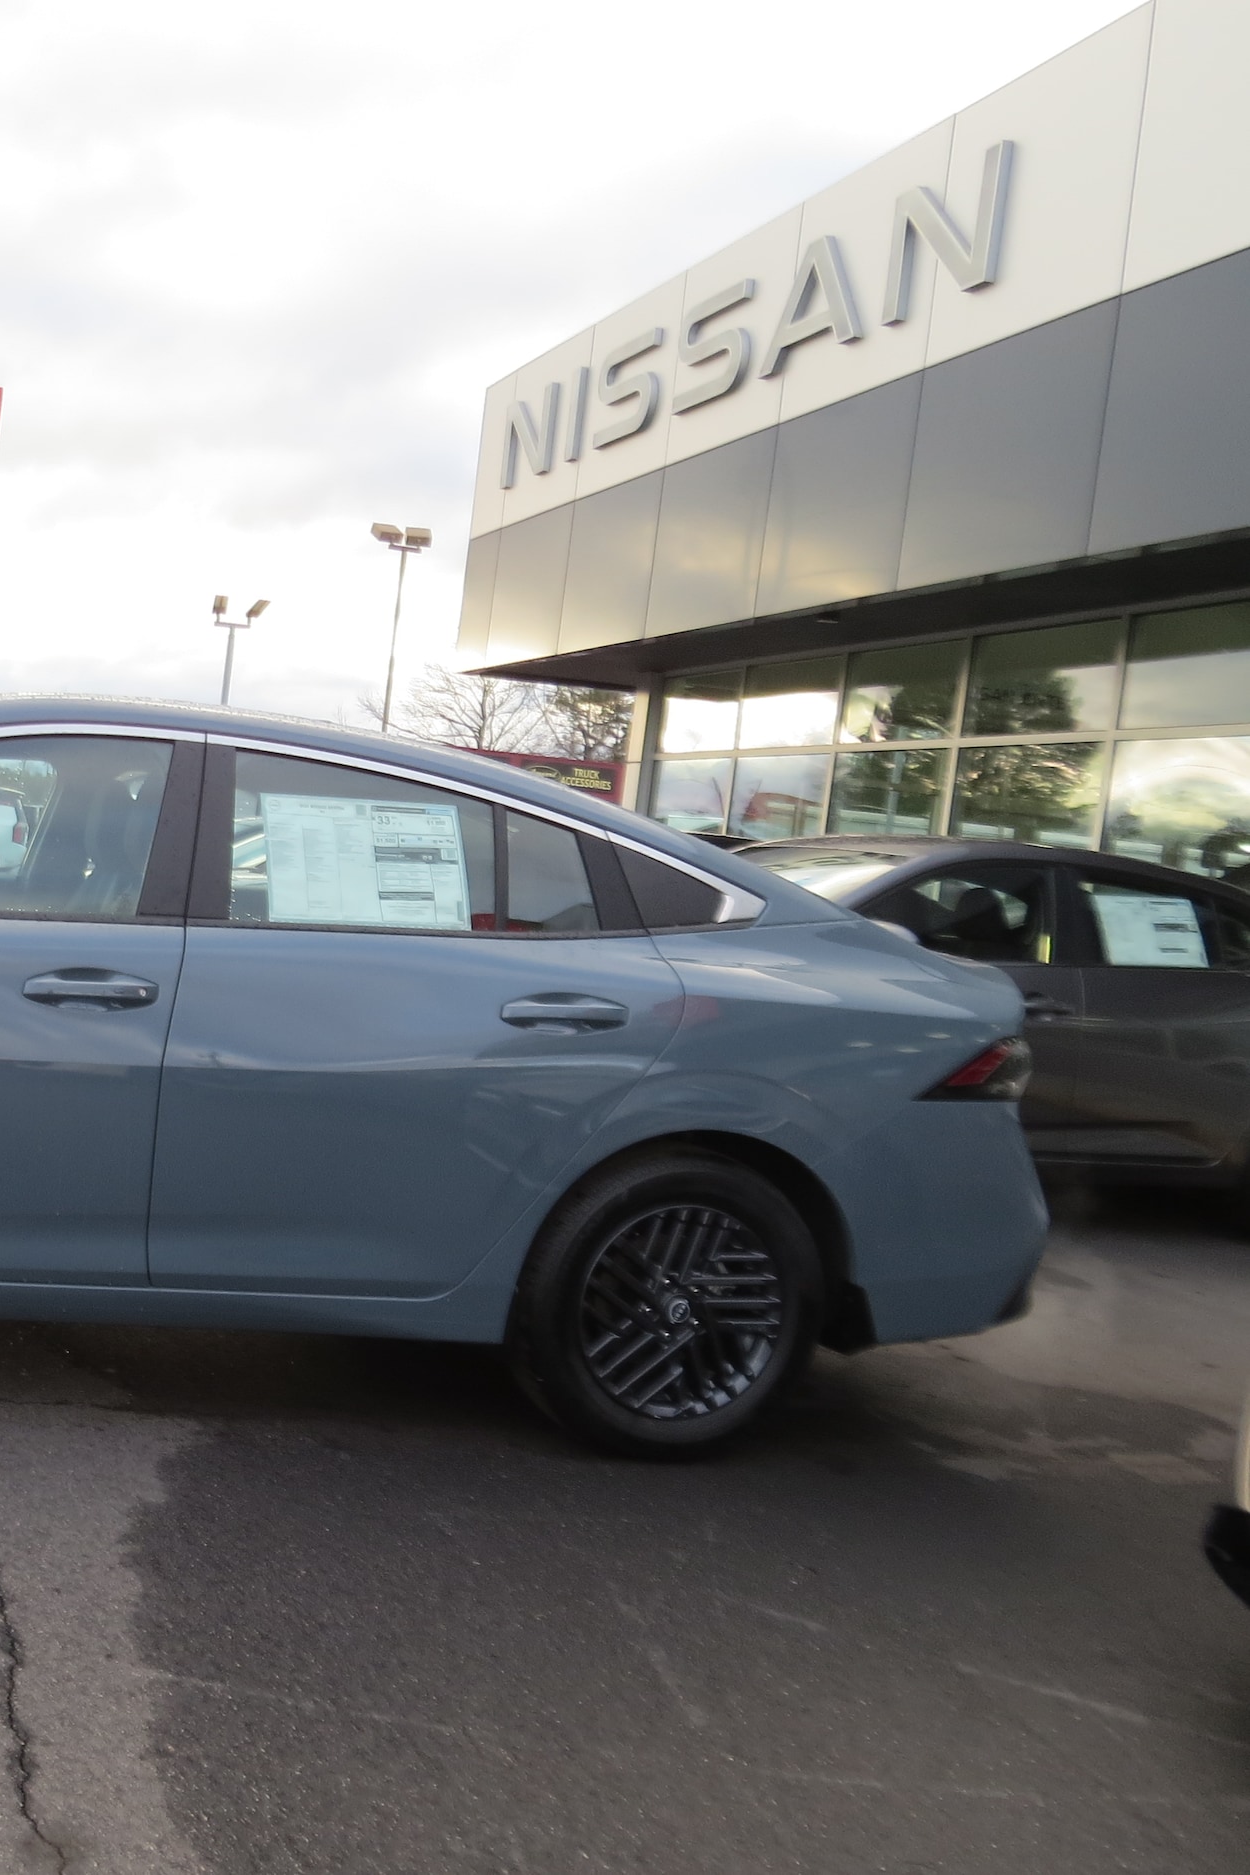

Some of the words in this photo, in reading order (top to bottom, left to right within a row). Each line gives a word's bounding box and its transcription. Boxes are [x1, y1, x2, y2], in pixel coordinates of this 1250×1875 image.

[499, 139, 1014, 490] NISSAN
[574, 767, 601, 780] TRUCK
[561, 776, 612, 791] ACCESSORIES
